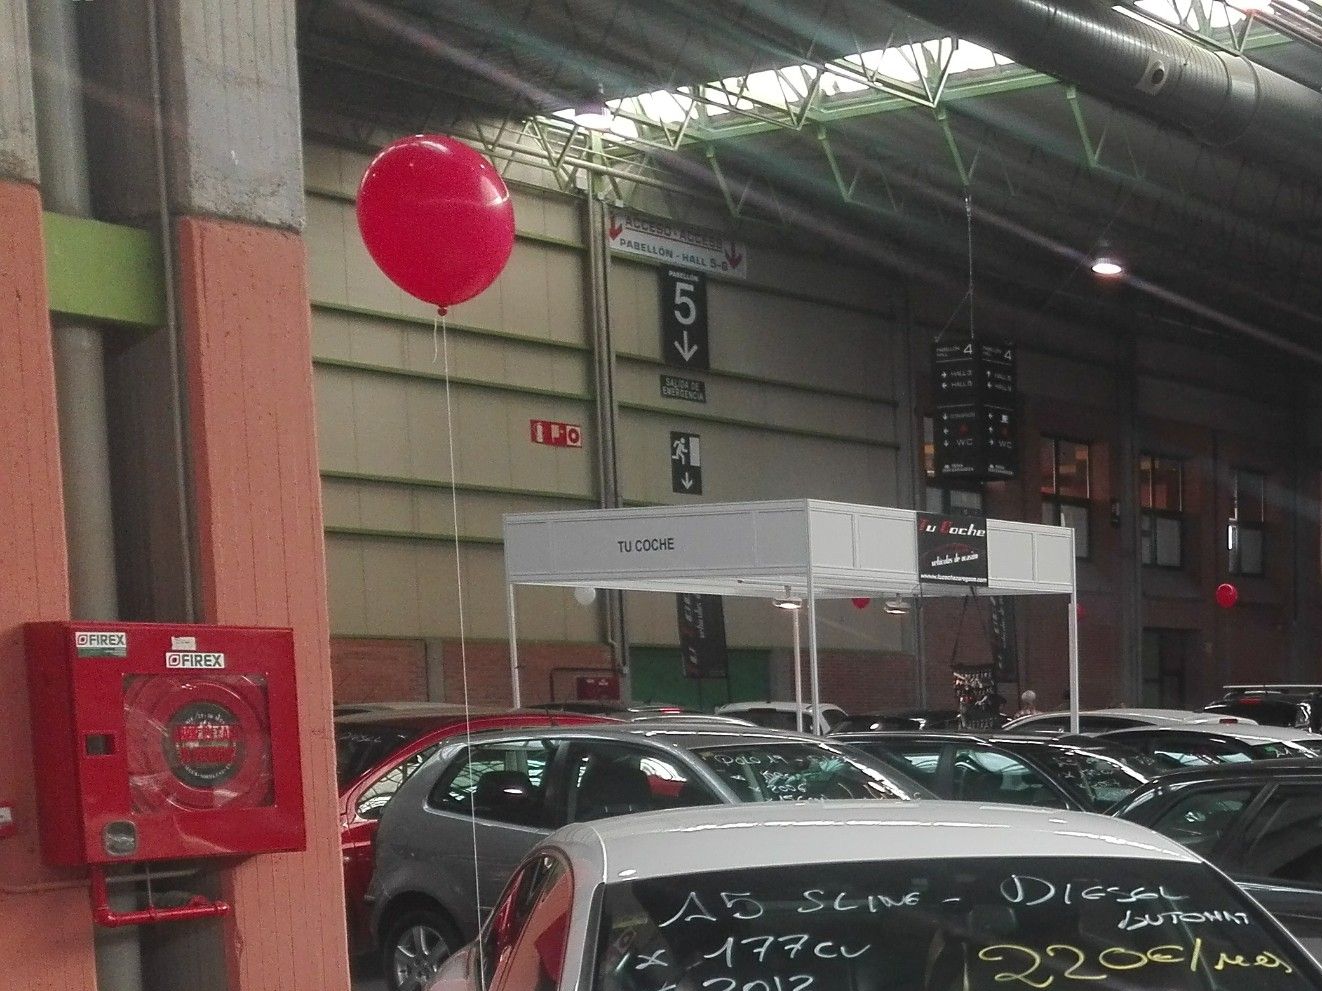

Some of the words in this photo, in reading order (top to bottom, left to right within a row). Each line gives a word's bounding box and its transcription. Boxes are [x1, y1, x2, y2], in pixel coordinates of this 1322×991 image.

[619, 238, 673, 259] PABELLÓN
[682, 253, 707, 266] HALL
[674, 282, 697, 325] 5
[963, 343, 973, 355] 4
[1004, 350, 1012, 360] 4
[919, 518, 937, 533] Tu
[939, 519, 986, 537] Coche
[617, 540, 632, 553] TU
[635, 537, 675, 552] COCHE
[89, 634, 125, 646] FIREX
[182, 654, 223, 668] FIREX
[658, 891, 764, 927] A5
[1000, 875, 1190, 905] DIESEL
